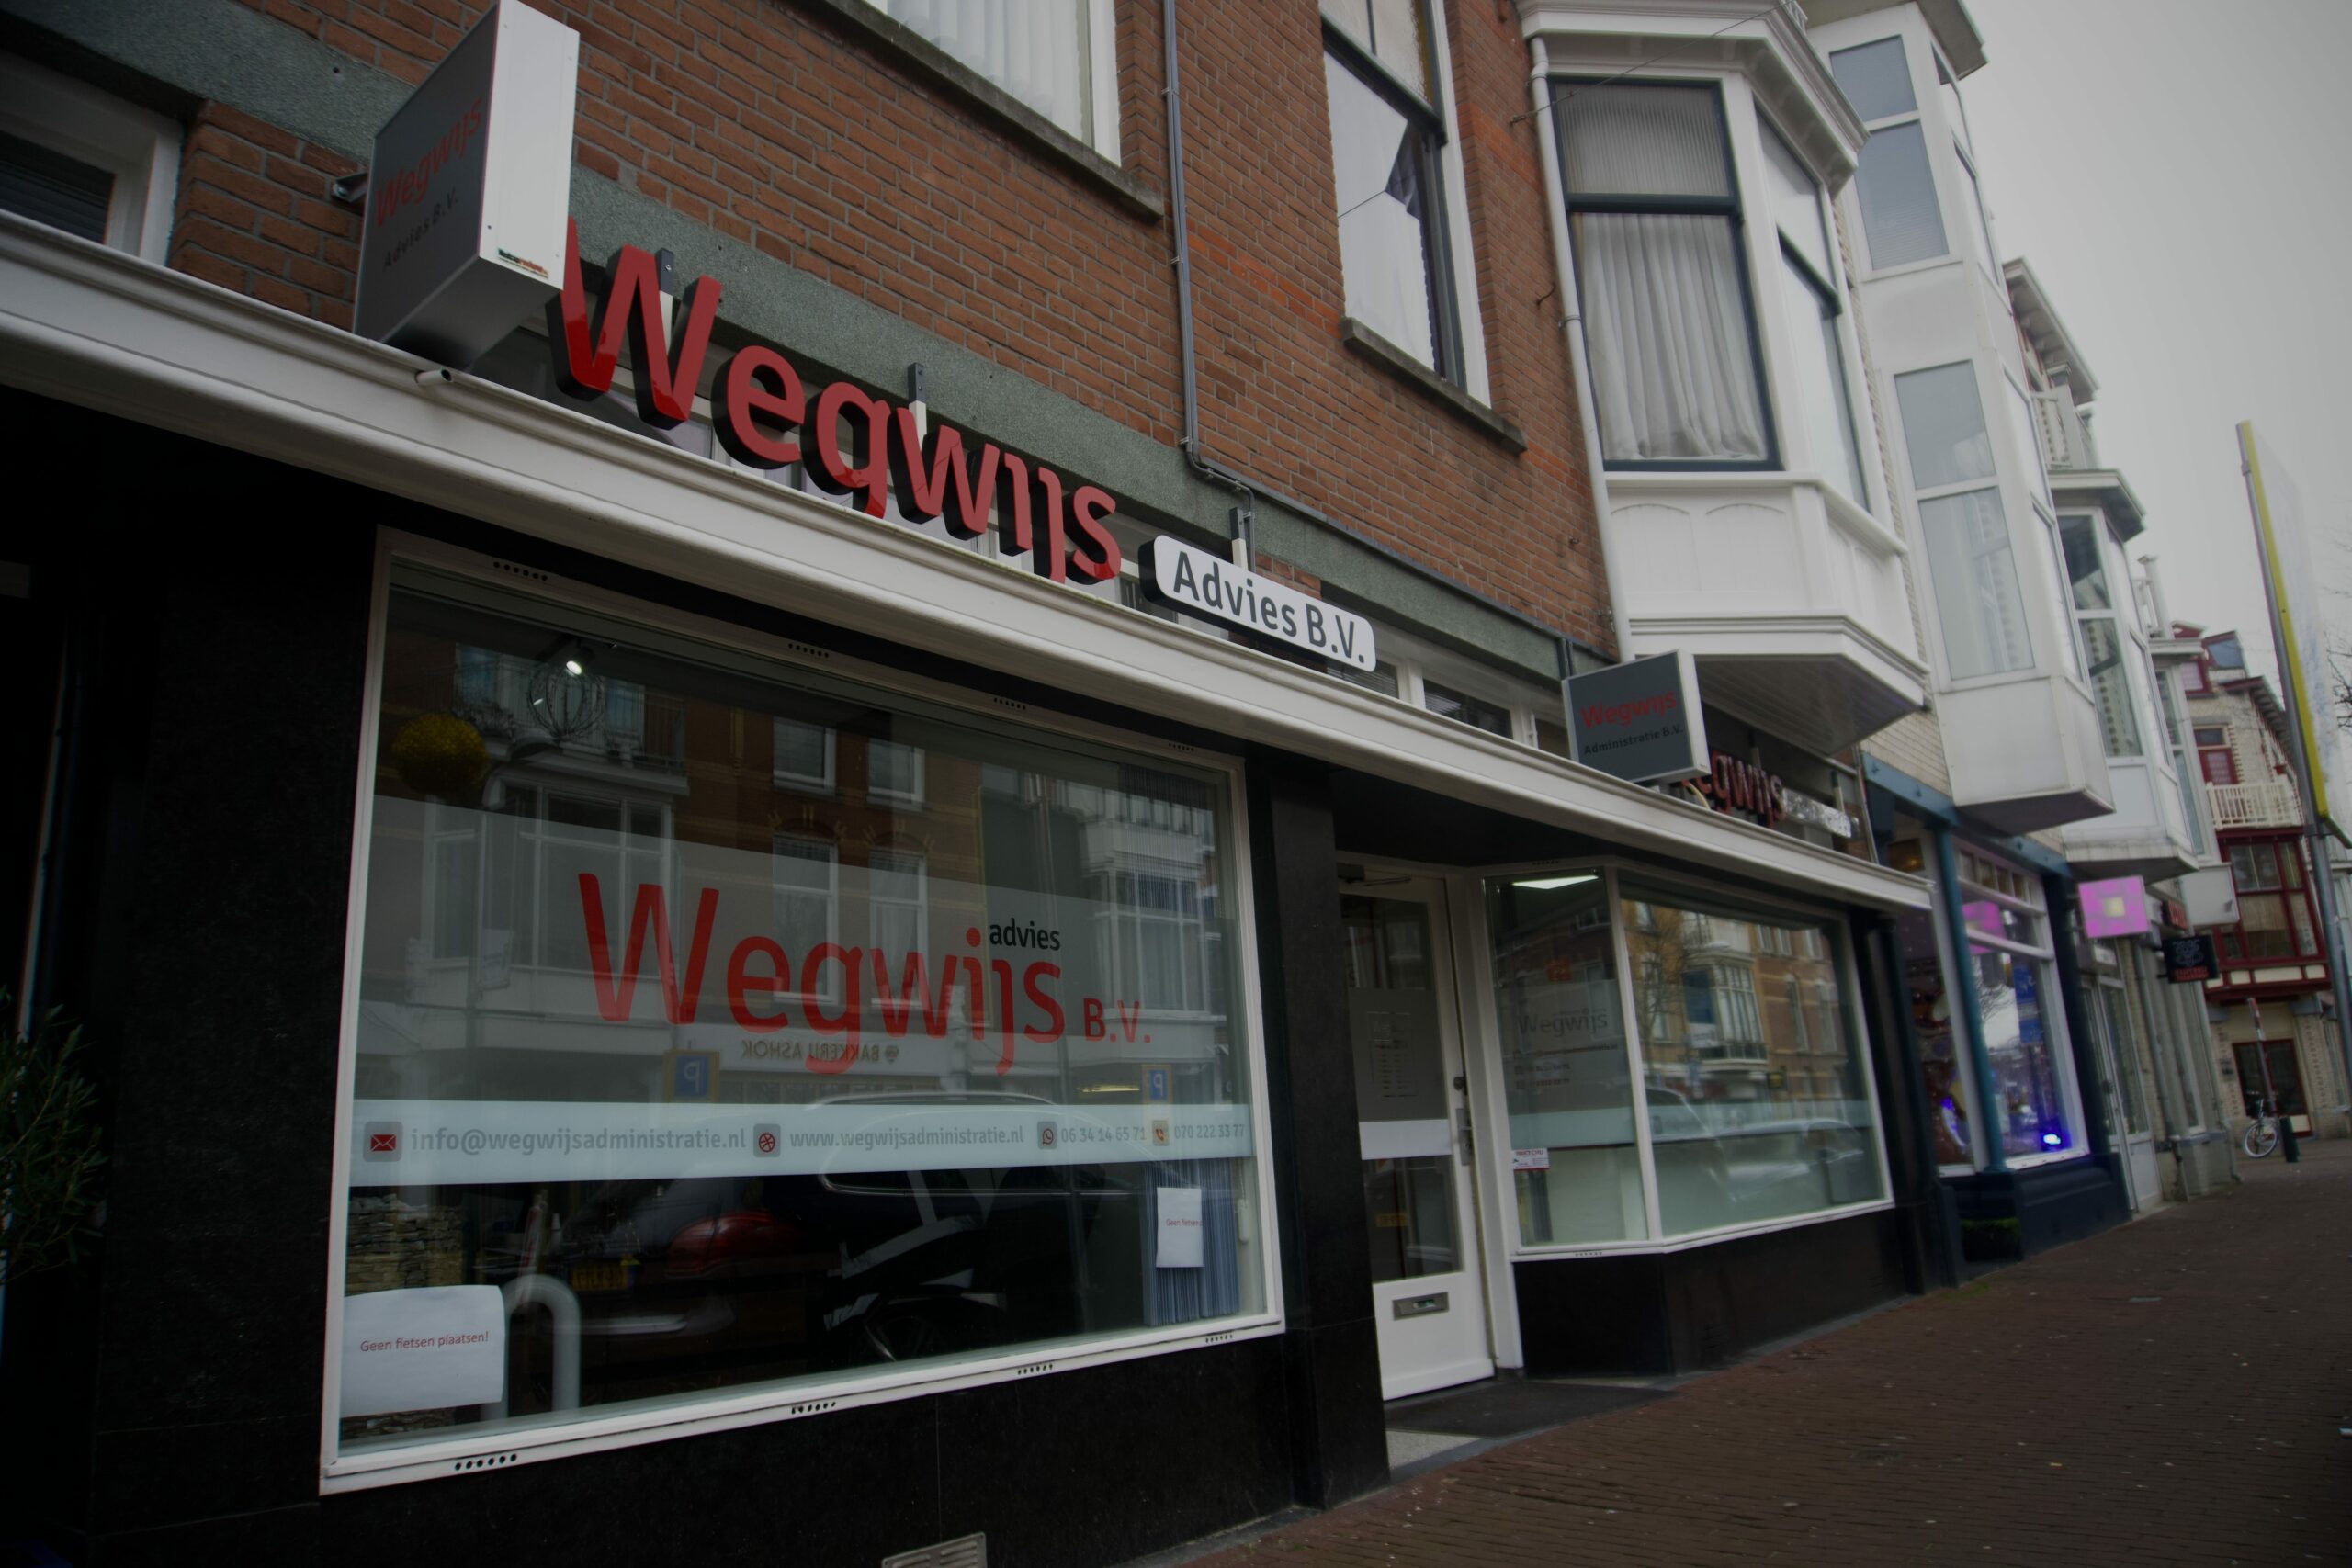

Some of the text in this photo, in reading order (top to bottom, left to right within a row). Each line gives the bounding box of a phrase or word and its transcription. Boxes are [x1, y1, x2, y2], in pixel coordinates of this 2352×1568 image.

[375, 97, 482, 228] Wegwijs
[383, 218, 431, 272] Advies
[1173, 551, 1365, 664] Advies B.V.
[1579, 691, 1678, 728] Wegwijs
[1583, 723, 1685, 756] Administratie B.V.
[989, 919, 1061, 951] advies
[578, 873, 1151, 1077] Wegwijs B.V.
[411, 1127, 747, 1156] info@wegwijsadministratie.nl
[789, 1124, 1024, 1151] www.wegwijsadministratie.nl
[360, 1331, 489, 1352] Geen fietsen plaatsen!
